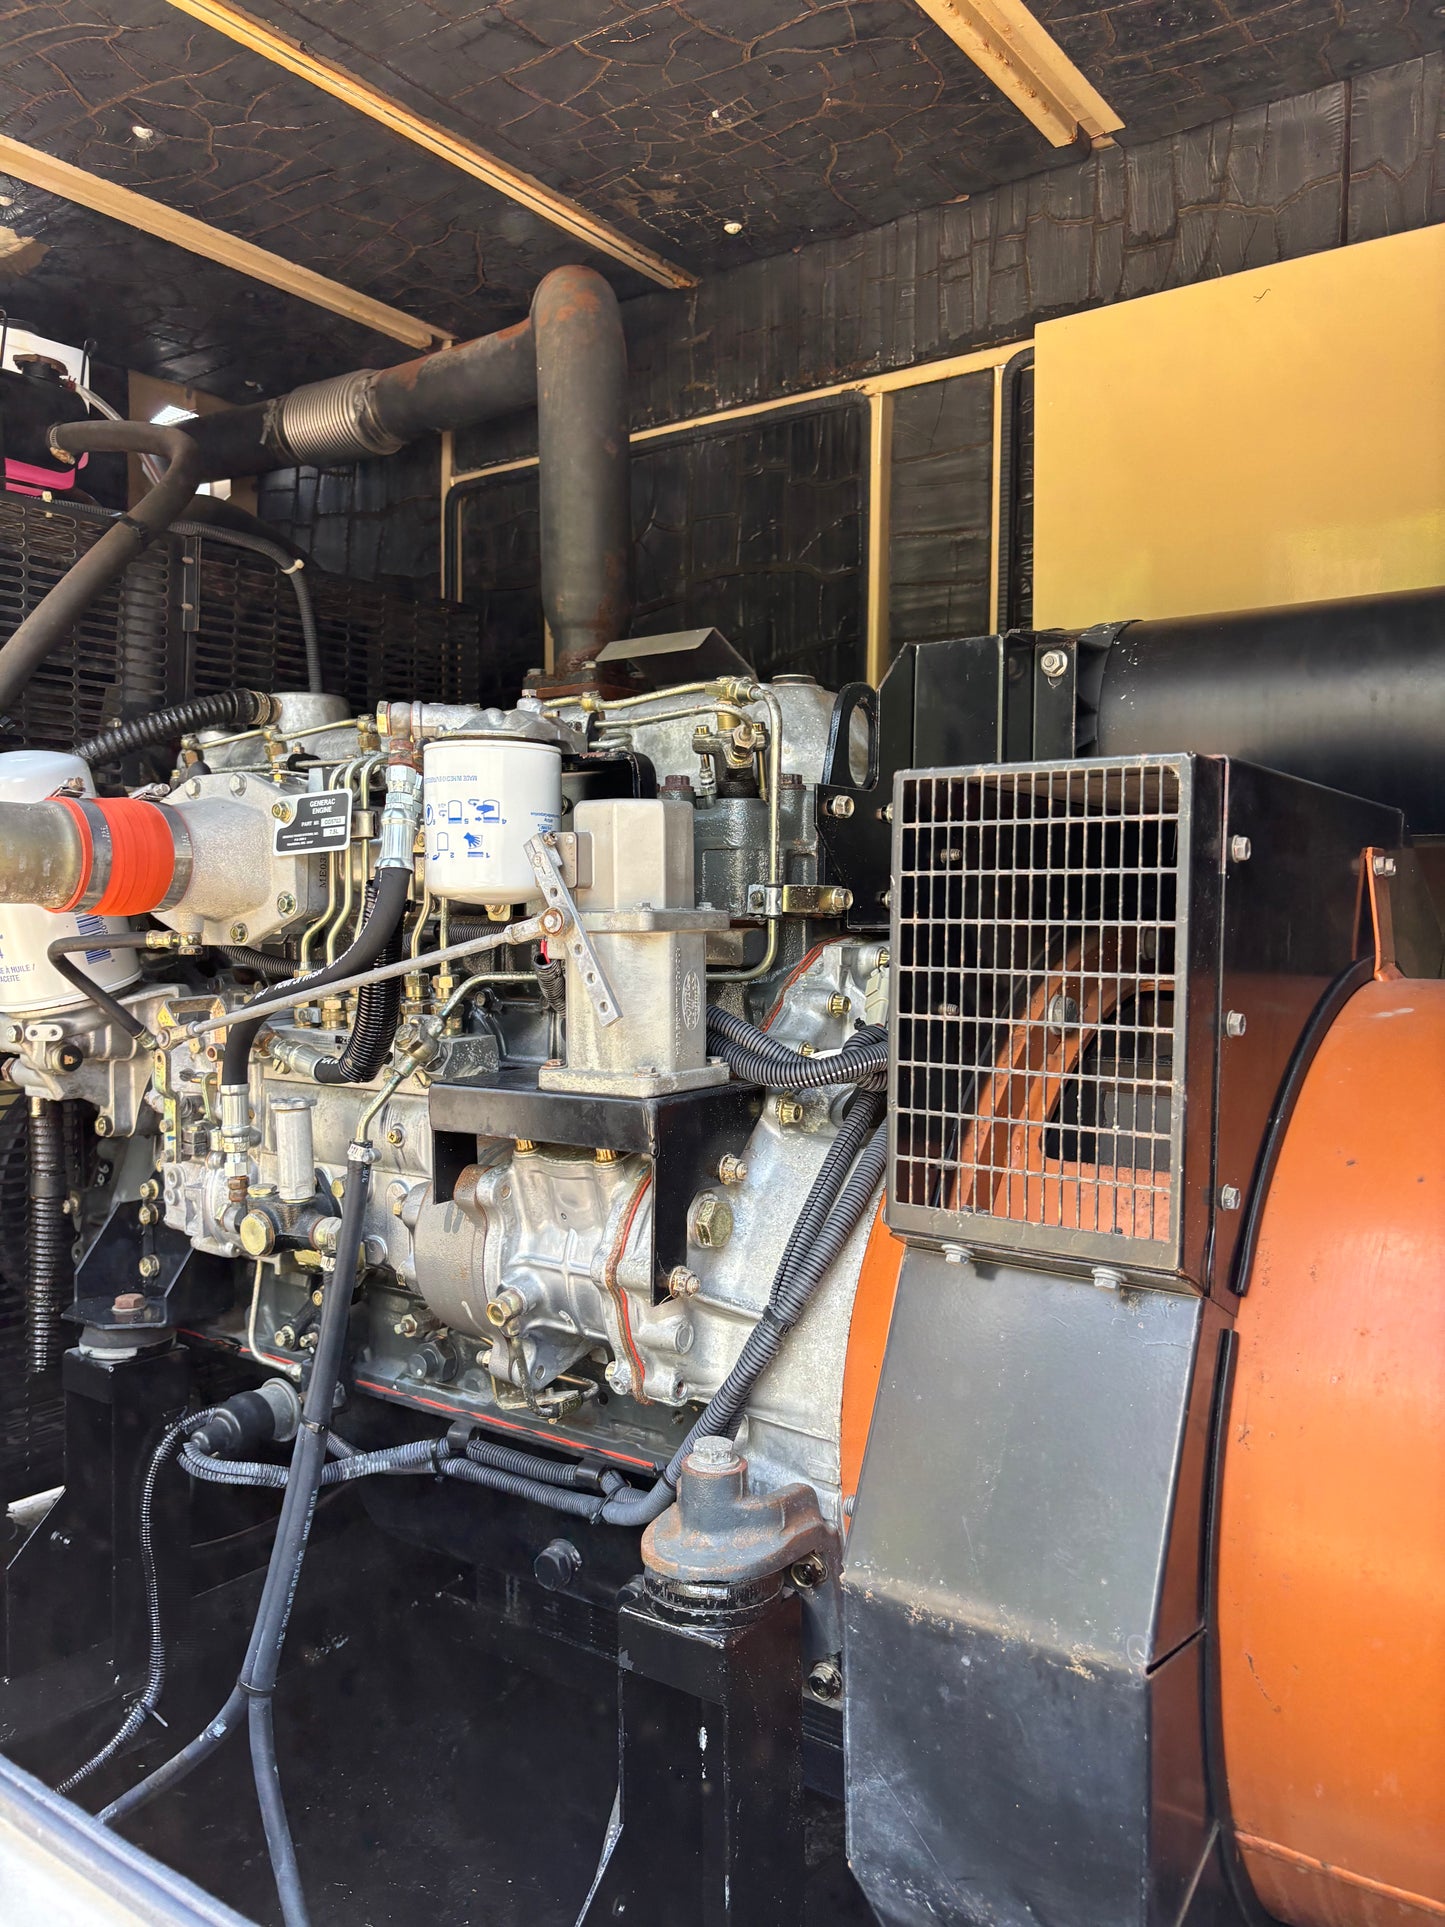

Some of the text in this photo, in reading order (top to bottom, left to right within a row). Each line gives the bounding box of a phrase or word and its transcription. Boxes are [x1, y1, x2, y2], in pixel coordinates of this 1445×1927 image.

[309, 798, 336, 808] GENERAC
[312, 806, 332, 815] ENGINE
[319, 855, 327, 888] ME03
[10, 963, 31, 973] HUILE
